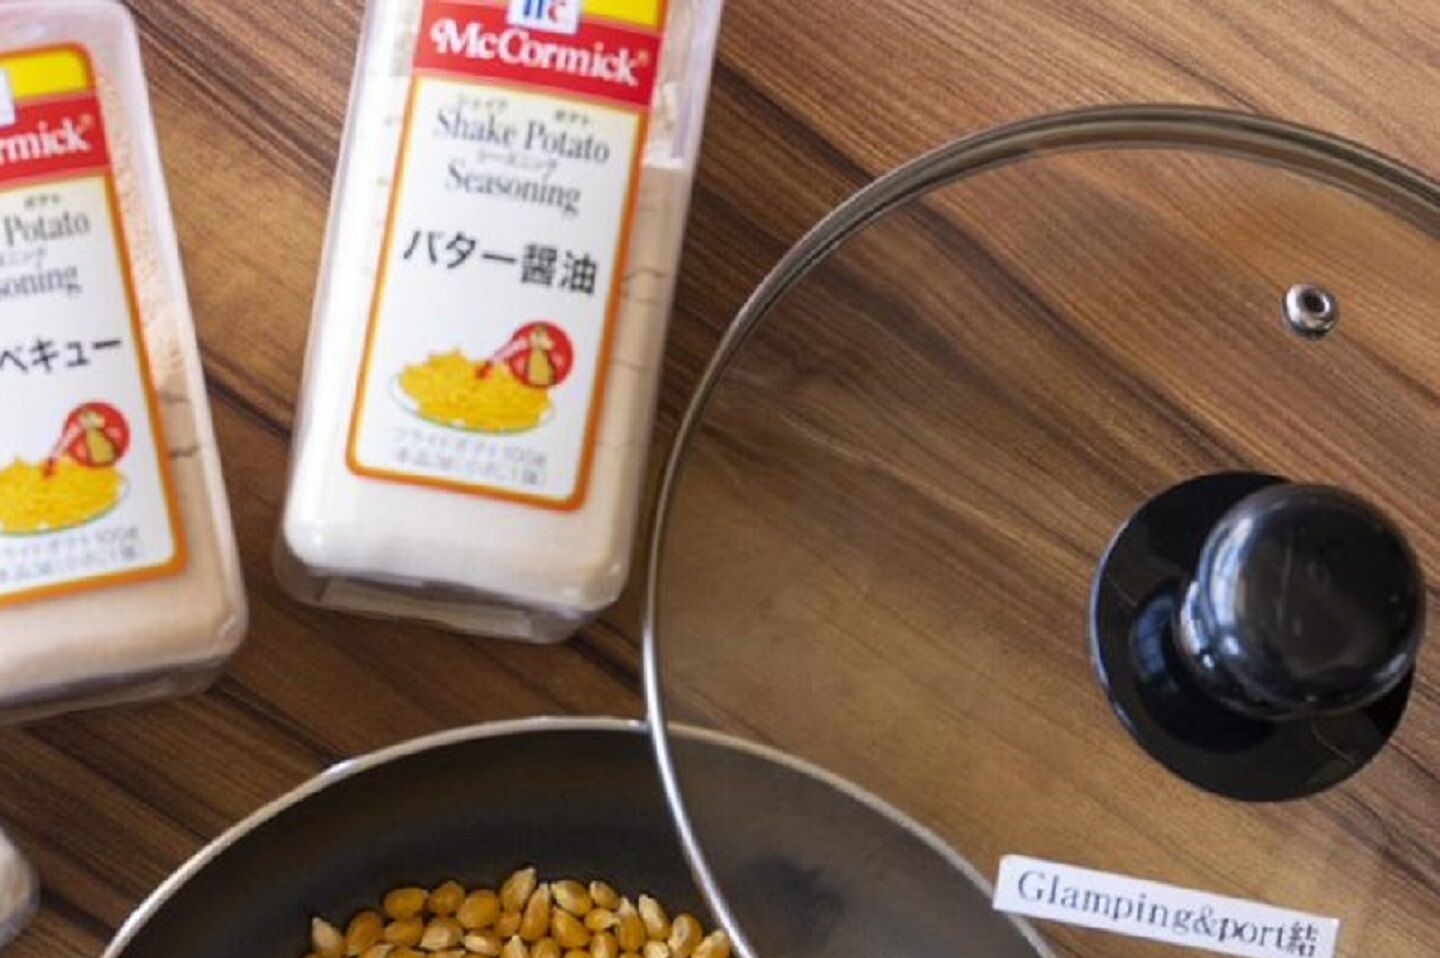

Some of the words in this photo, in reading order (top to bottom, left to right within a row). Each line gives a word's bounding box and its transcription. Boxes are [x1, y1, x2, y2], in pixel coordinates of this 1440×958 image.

[434, 105, 516, 146] Shake
[524, 120, 610, 164] Potato
[446, 159, 581, 217] Seasoning
[3, 211, 90, 247] Potato
[403, 230, 598, 295] バター醤油
[1017, 869, 1320, 958] Glamping&port結
